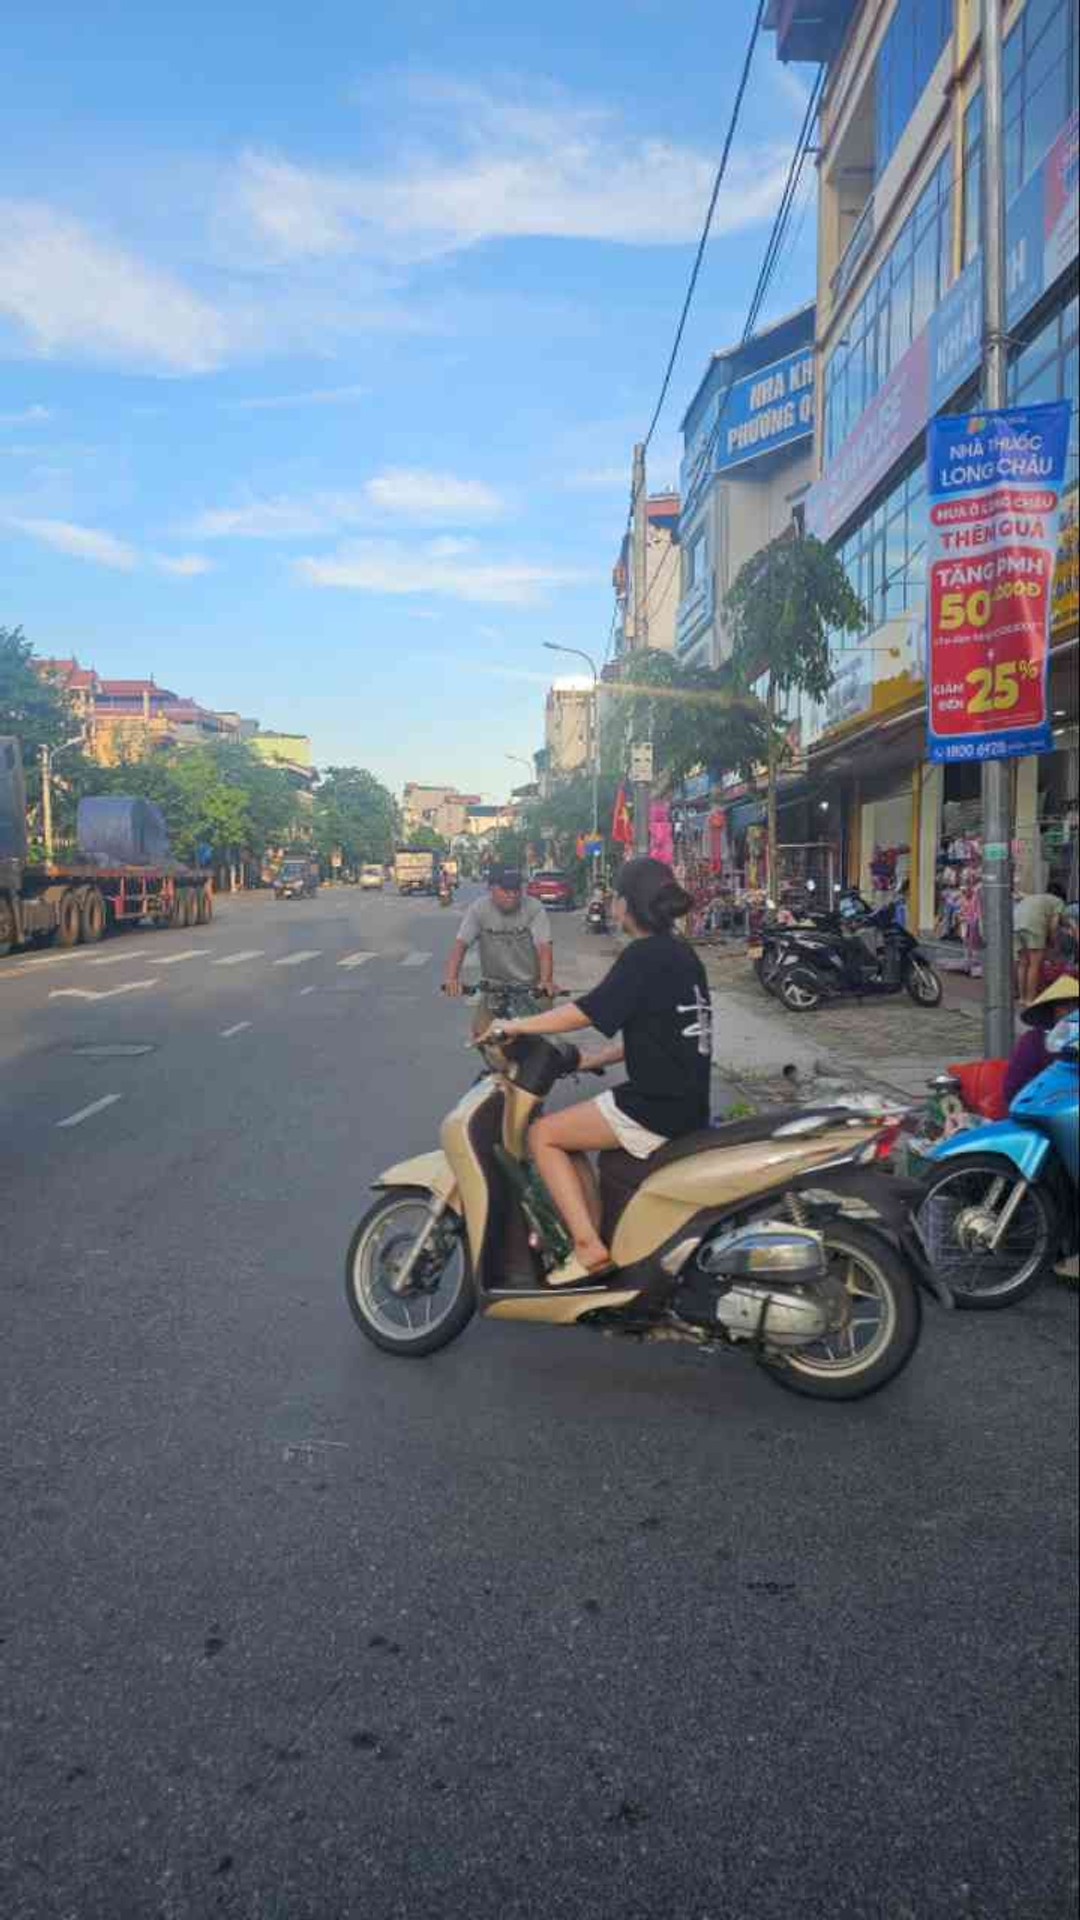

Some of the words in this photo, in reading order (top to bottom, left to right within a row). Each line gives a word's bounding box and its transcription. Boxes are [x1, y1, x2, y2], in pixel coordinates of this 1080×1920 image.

[950, 436, 985, 460] NHÀ
[988, 430, 1043, 453] THUỐC
[941, 462, 994, 486] LONG
[996, 452, 1053, 476] CHÂU
